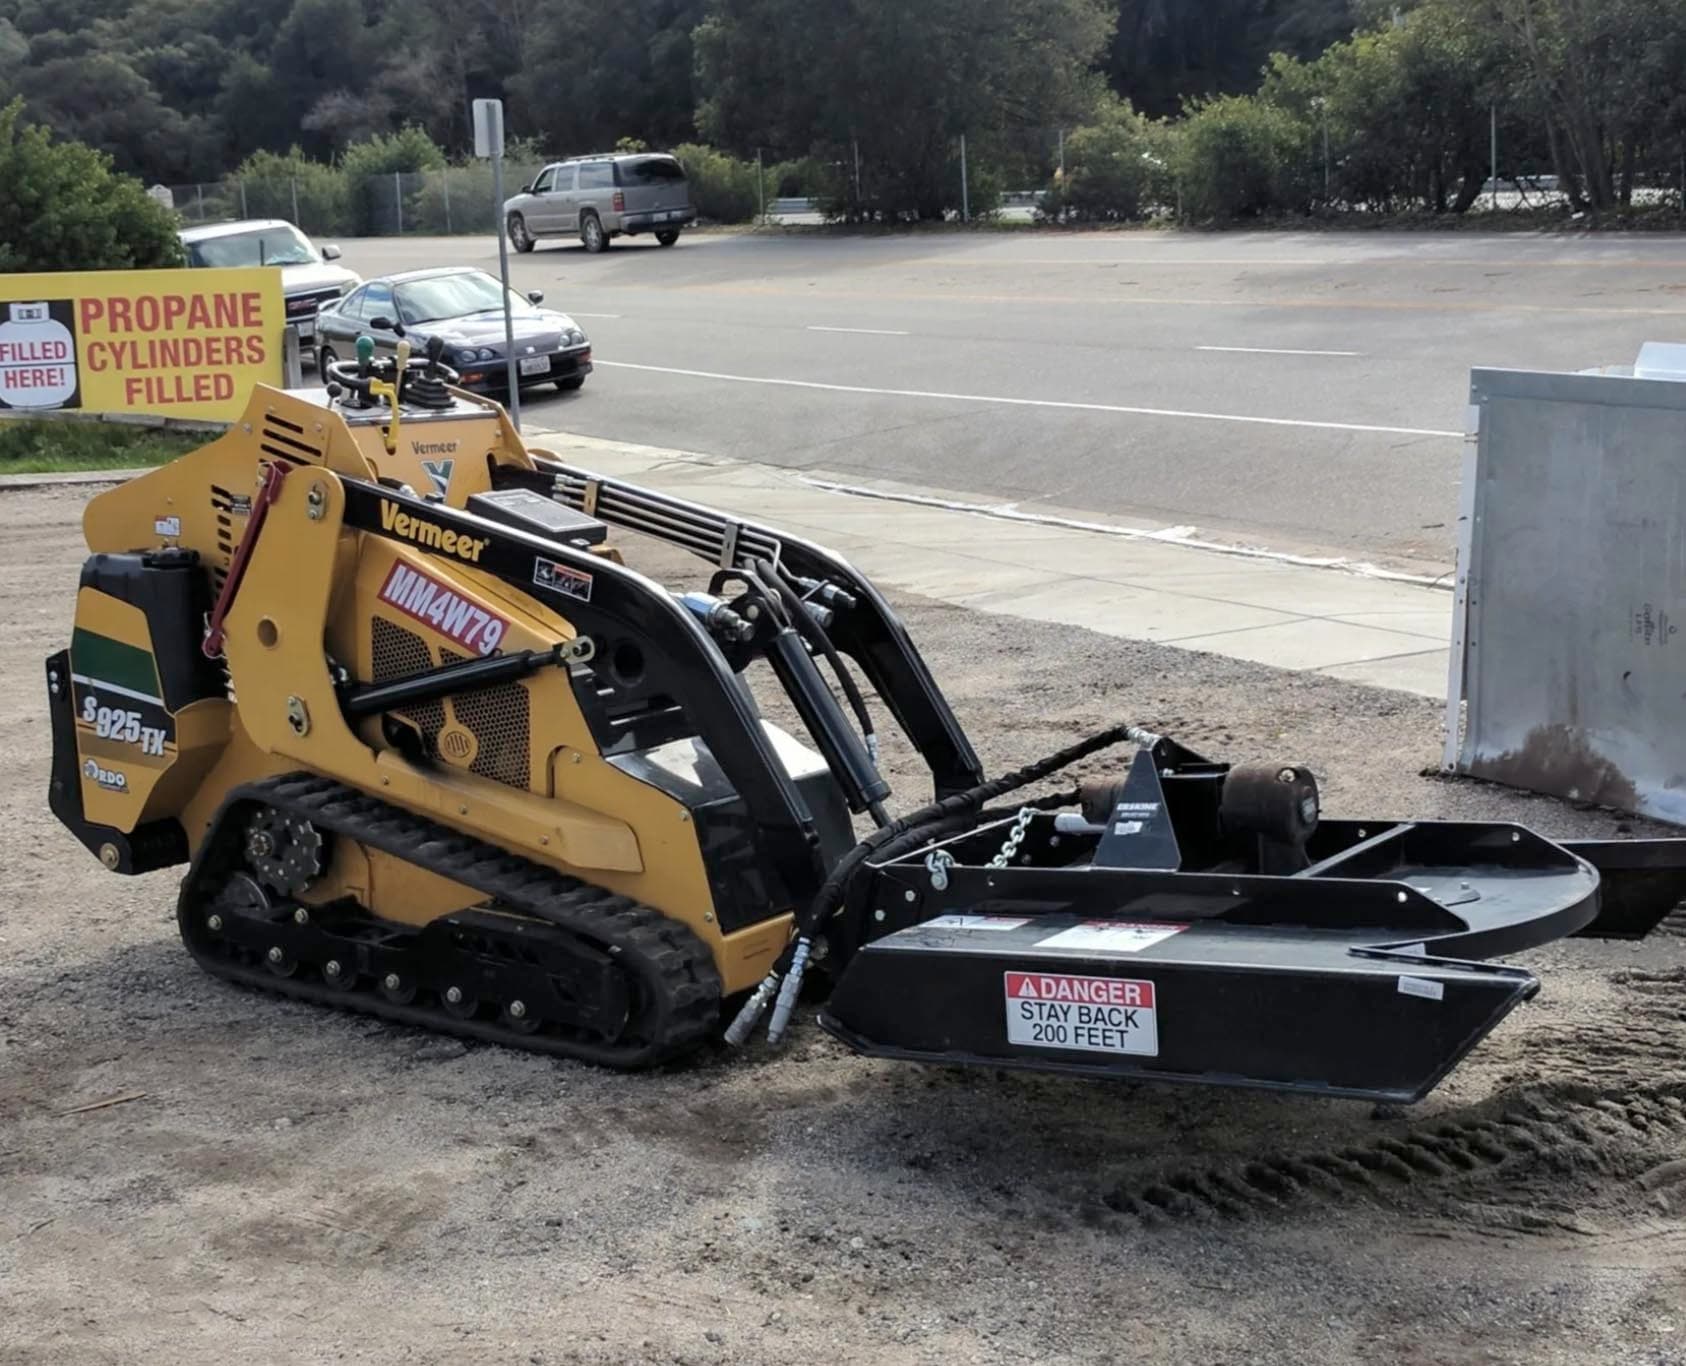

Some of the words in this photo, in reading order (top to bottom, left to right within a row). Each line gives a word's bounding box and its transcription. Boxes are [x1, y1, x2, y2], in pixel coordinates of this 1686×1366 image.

[80, 292, 264, 335] PROPANE
[0, 340, 67, 362] FILLED
[87, 335, 265, 372] CYLINDERS
[4, 367, 65, 389] HERE!
[125, 373, 235, 406] FILLED
[411, 440, 457, 455] Vermeer
[380, 498, 485, 562] Vermeer
[383, 563, 503, 655] MM4W79
[1040, 978, 1142, 1005] DANGER
[1020, 1001, 1072, 1023] STAY
[1078, 1006, 1139, 1028] BACK
[1032, 1023, 1067, 1043] 200
[1074, 1026, 1129, 1049] FEET
